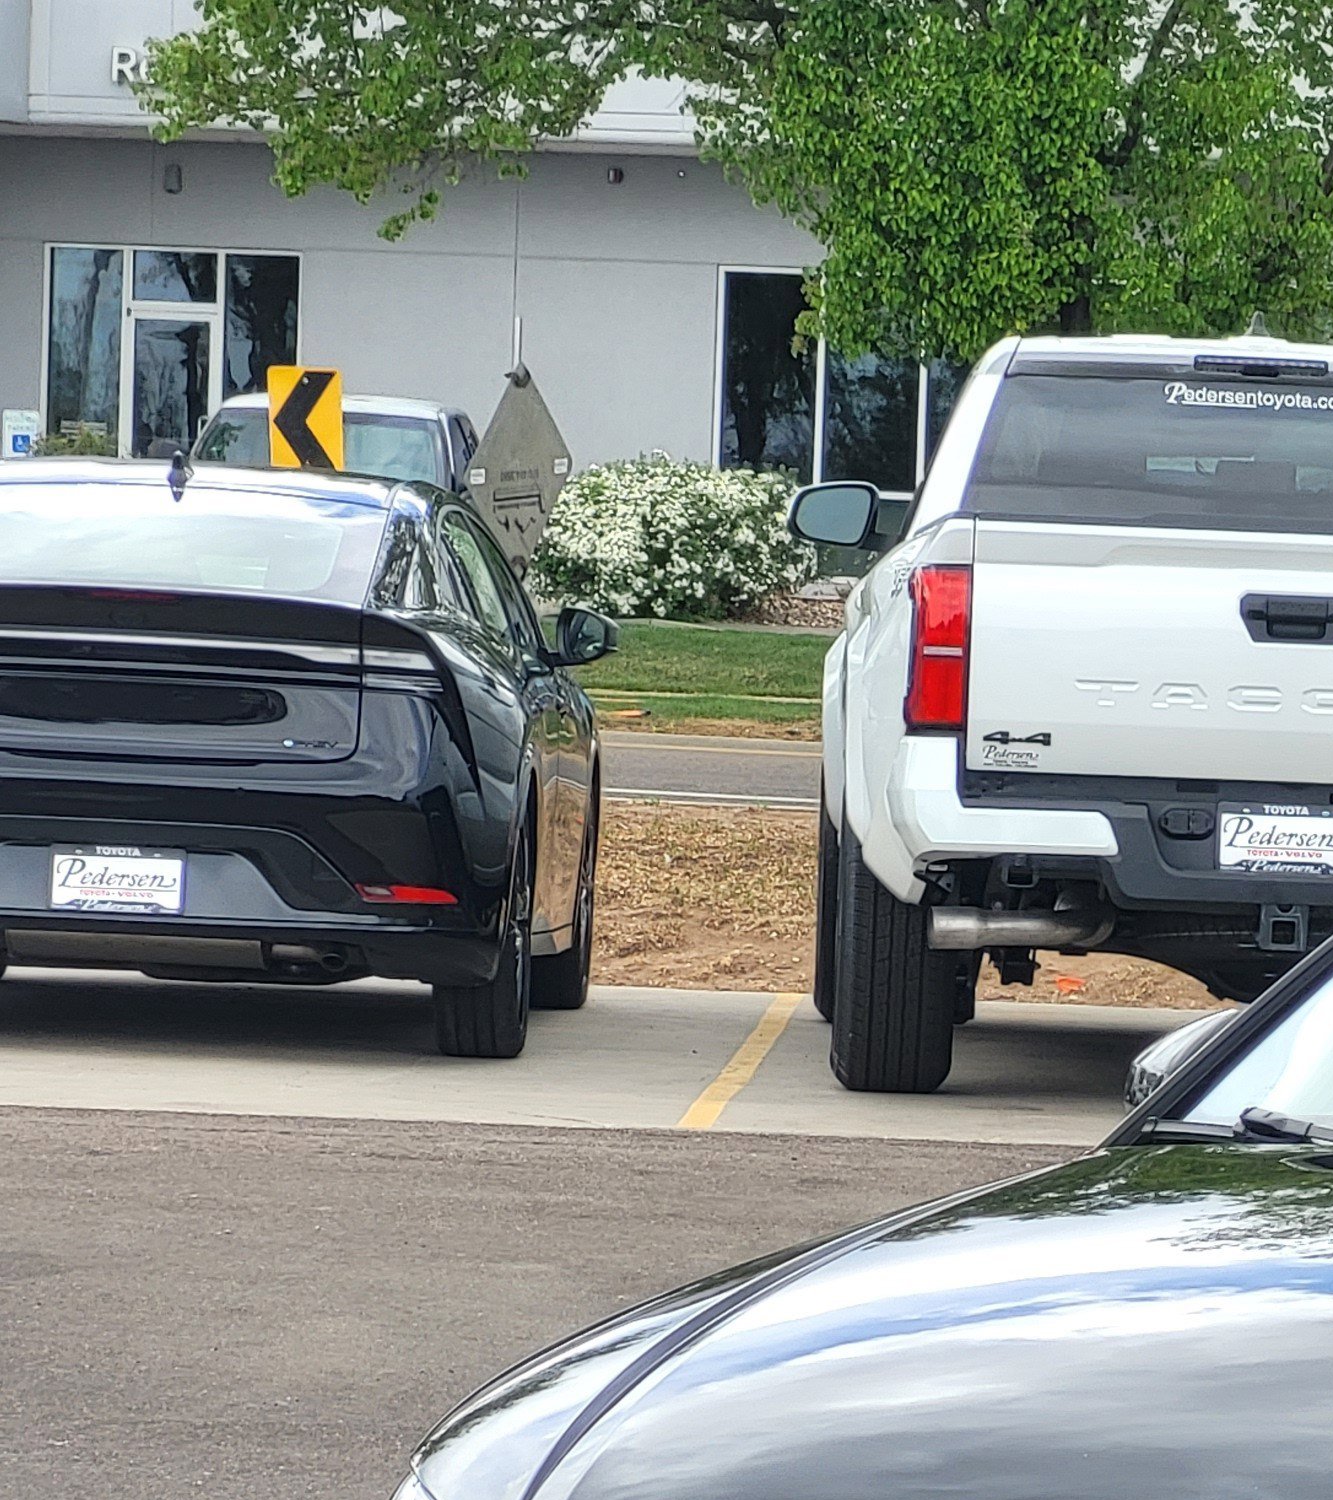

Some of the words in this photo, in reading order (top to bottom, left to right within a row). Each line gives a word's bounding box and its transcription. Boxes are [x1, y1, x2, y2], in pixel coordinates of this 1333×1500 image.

[1263, 804, 1310, 815] TOYOTA
[95, 845, 141, 857] TOYOTA
[1247, 849, 1279, 857] TOYOTA
[57, 857, 177, 889] Pedersen
